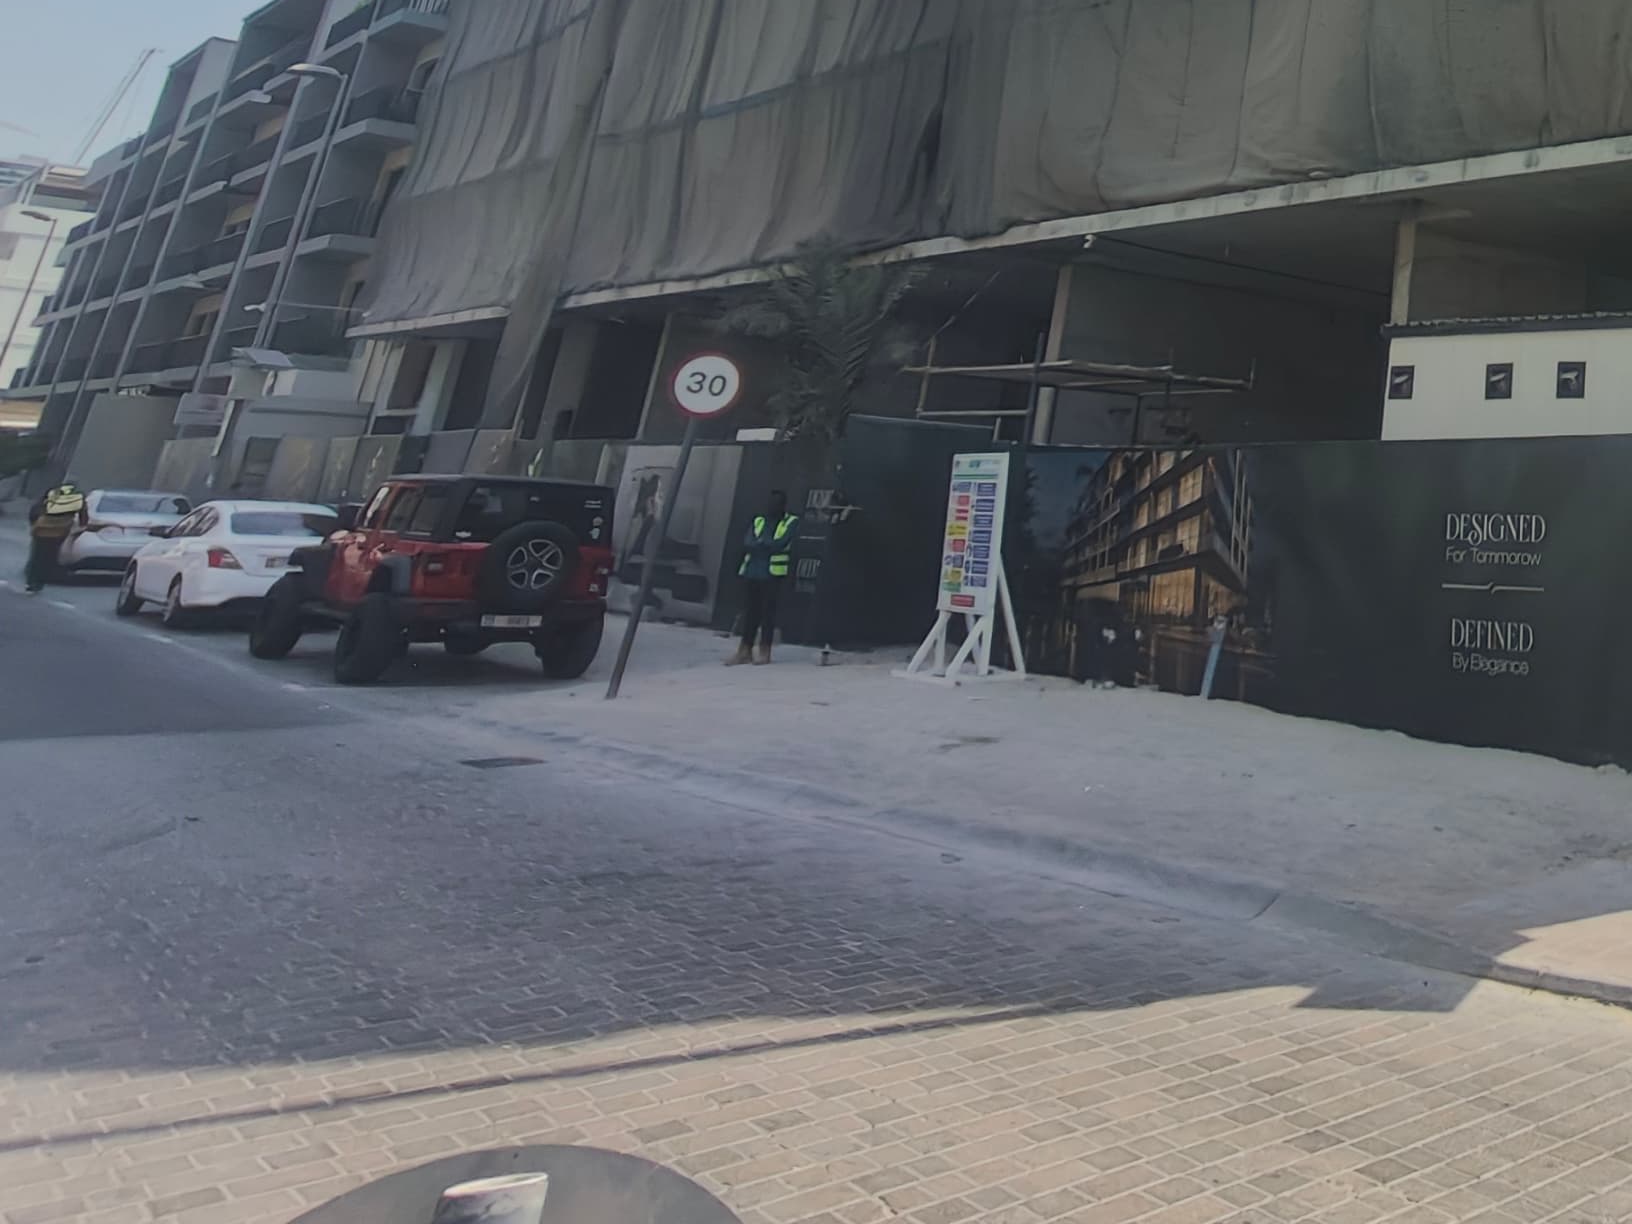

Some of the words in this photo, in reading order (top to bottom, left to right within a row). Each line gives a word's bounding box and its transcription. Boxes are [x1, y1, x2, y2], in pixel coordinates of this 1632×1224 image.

[686, 371, 727, 396] 30
[1445, 512, 1546, 546] DESIGNED
[1446, 545, 1468, 563] For
[1451, 618, 1534, 652] DEFINED
[1452, 651, 1469, 673] By
